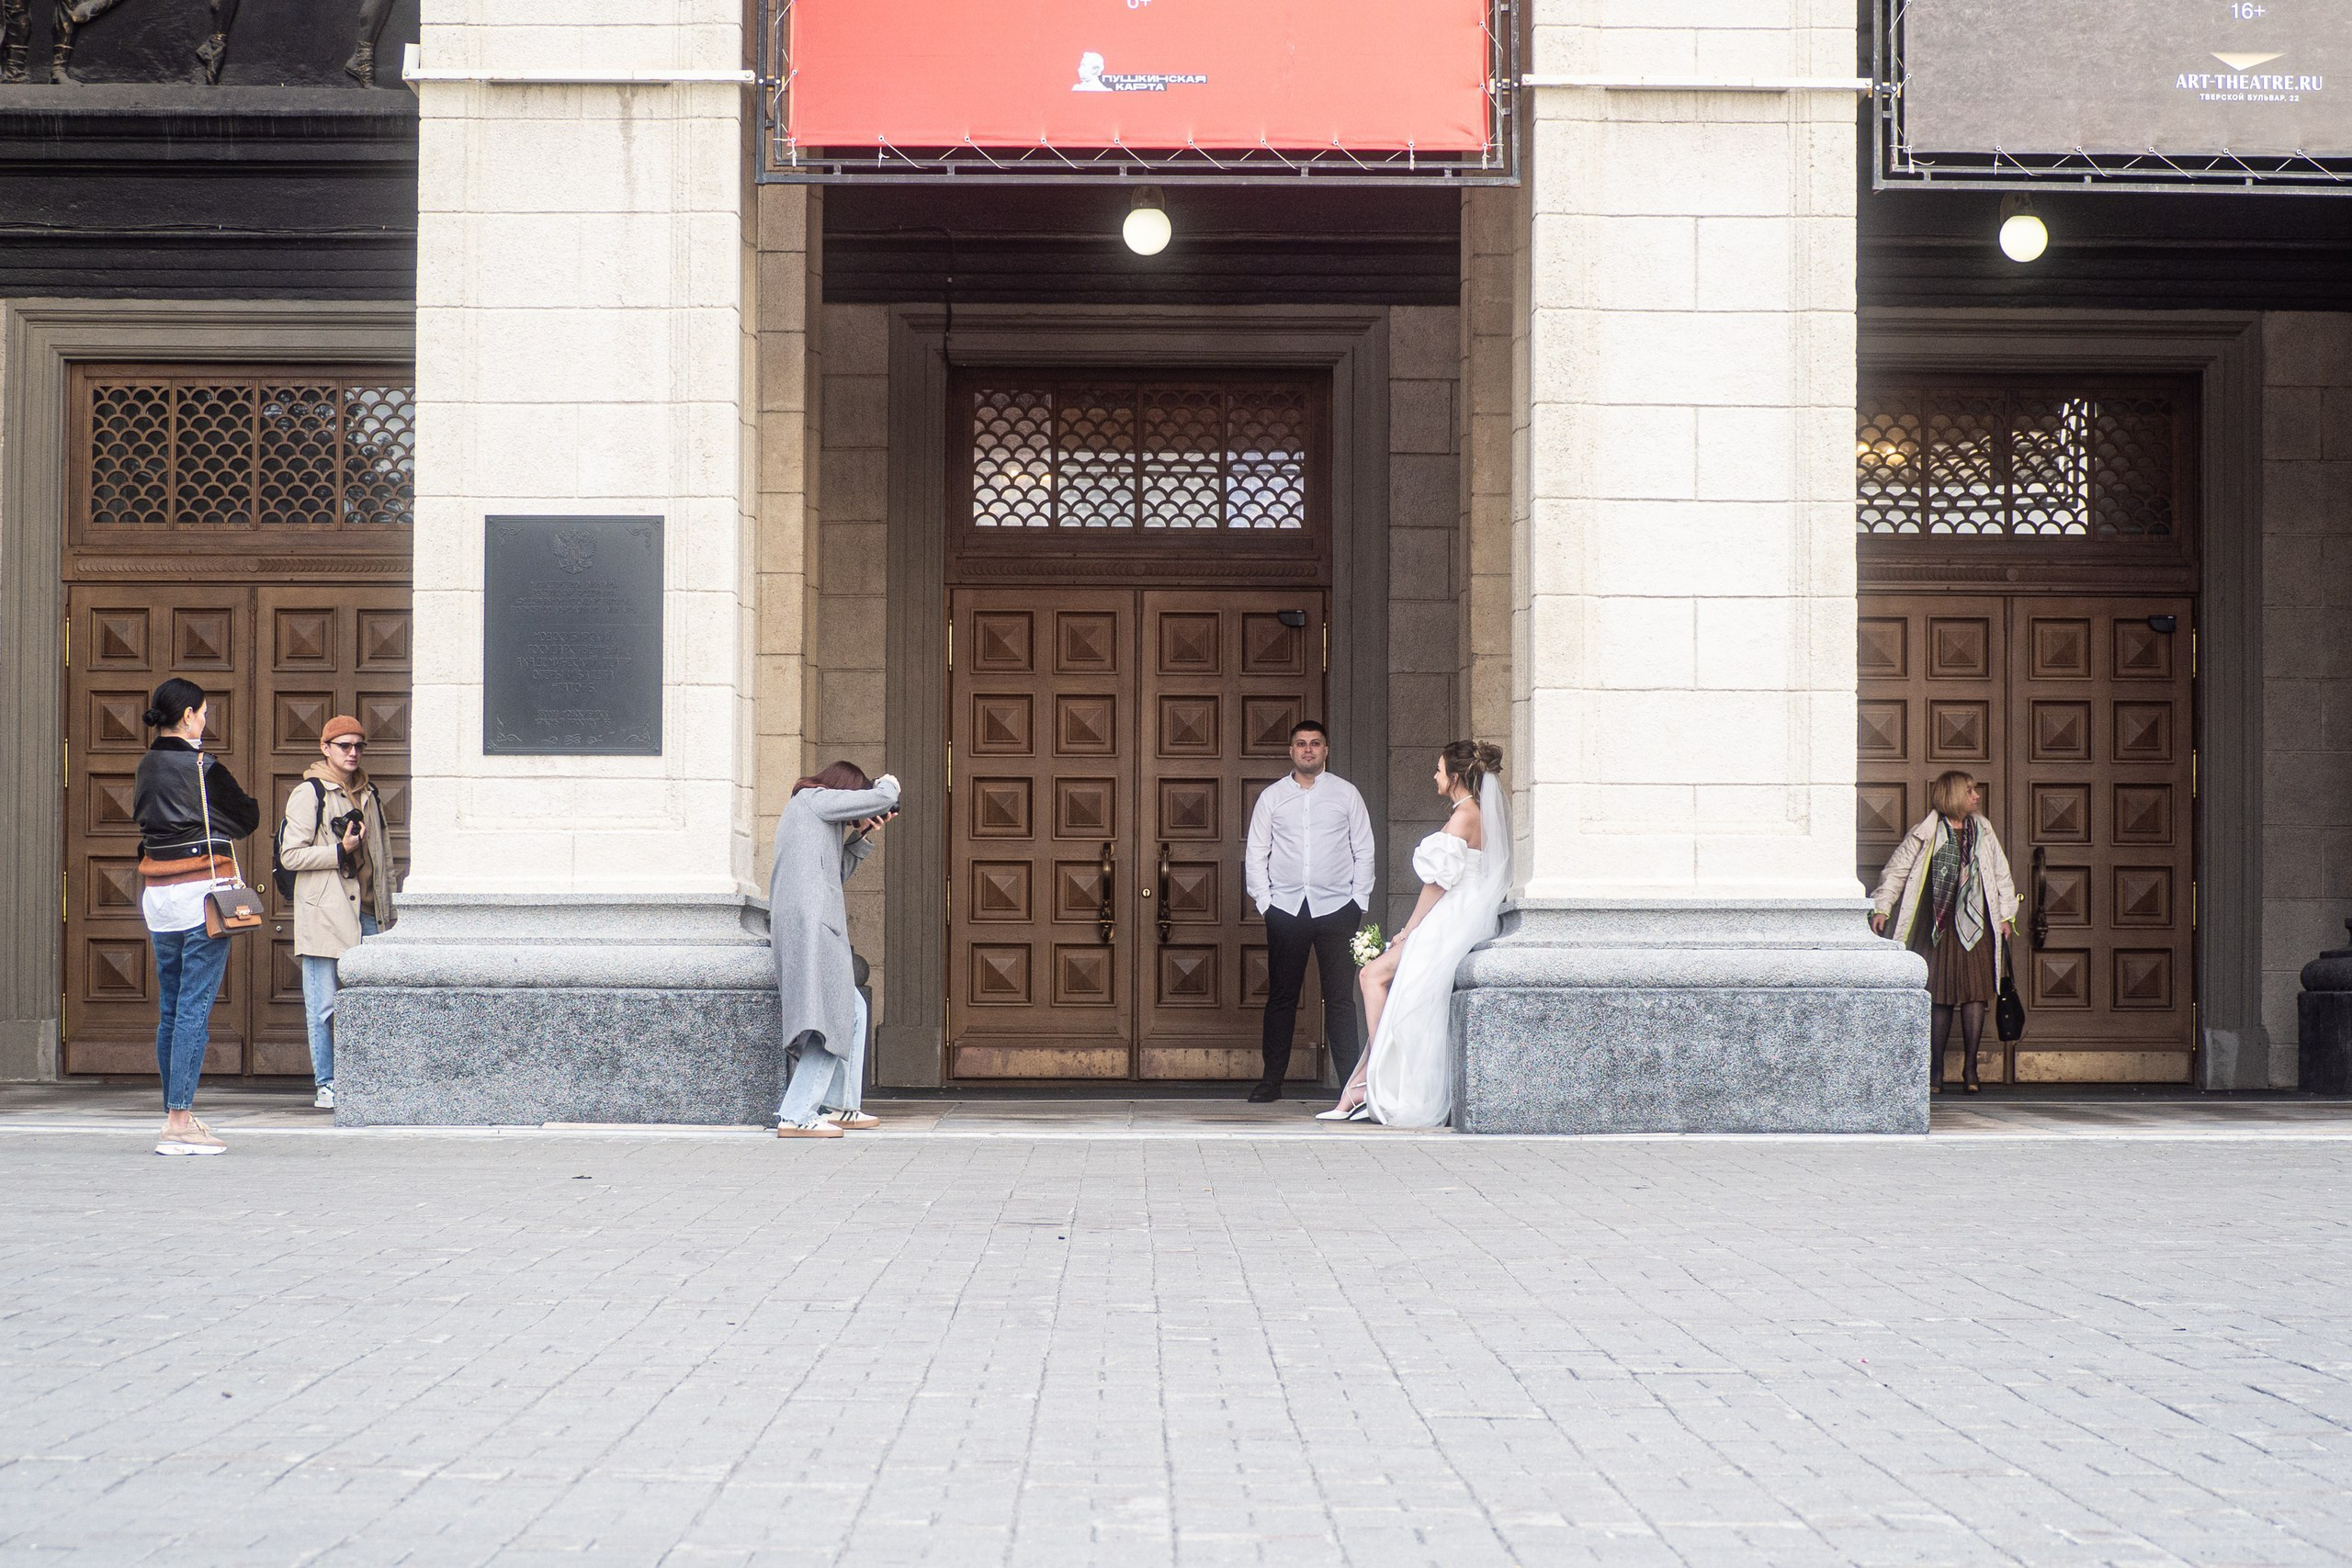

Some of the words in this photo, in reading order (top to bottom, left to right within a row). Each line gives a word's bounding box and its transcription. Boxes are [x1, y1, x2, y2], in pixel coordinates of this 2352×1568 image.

[2231, 2, 2266, 19] 16+
[1102, 74, 1207, 84] ПУШКИНСКАЯ
[2176, 73, 2323, 91] ART-THEATRE.RU
[1115, 83, 1165, 91] КАРТА
[2199, 93, 2245, 101] ТВЕРСКОЙ
